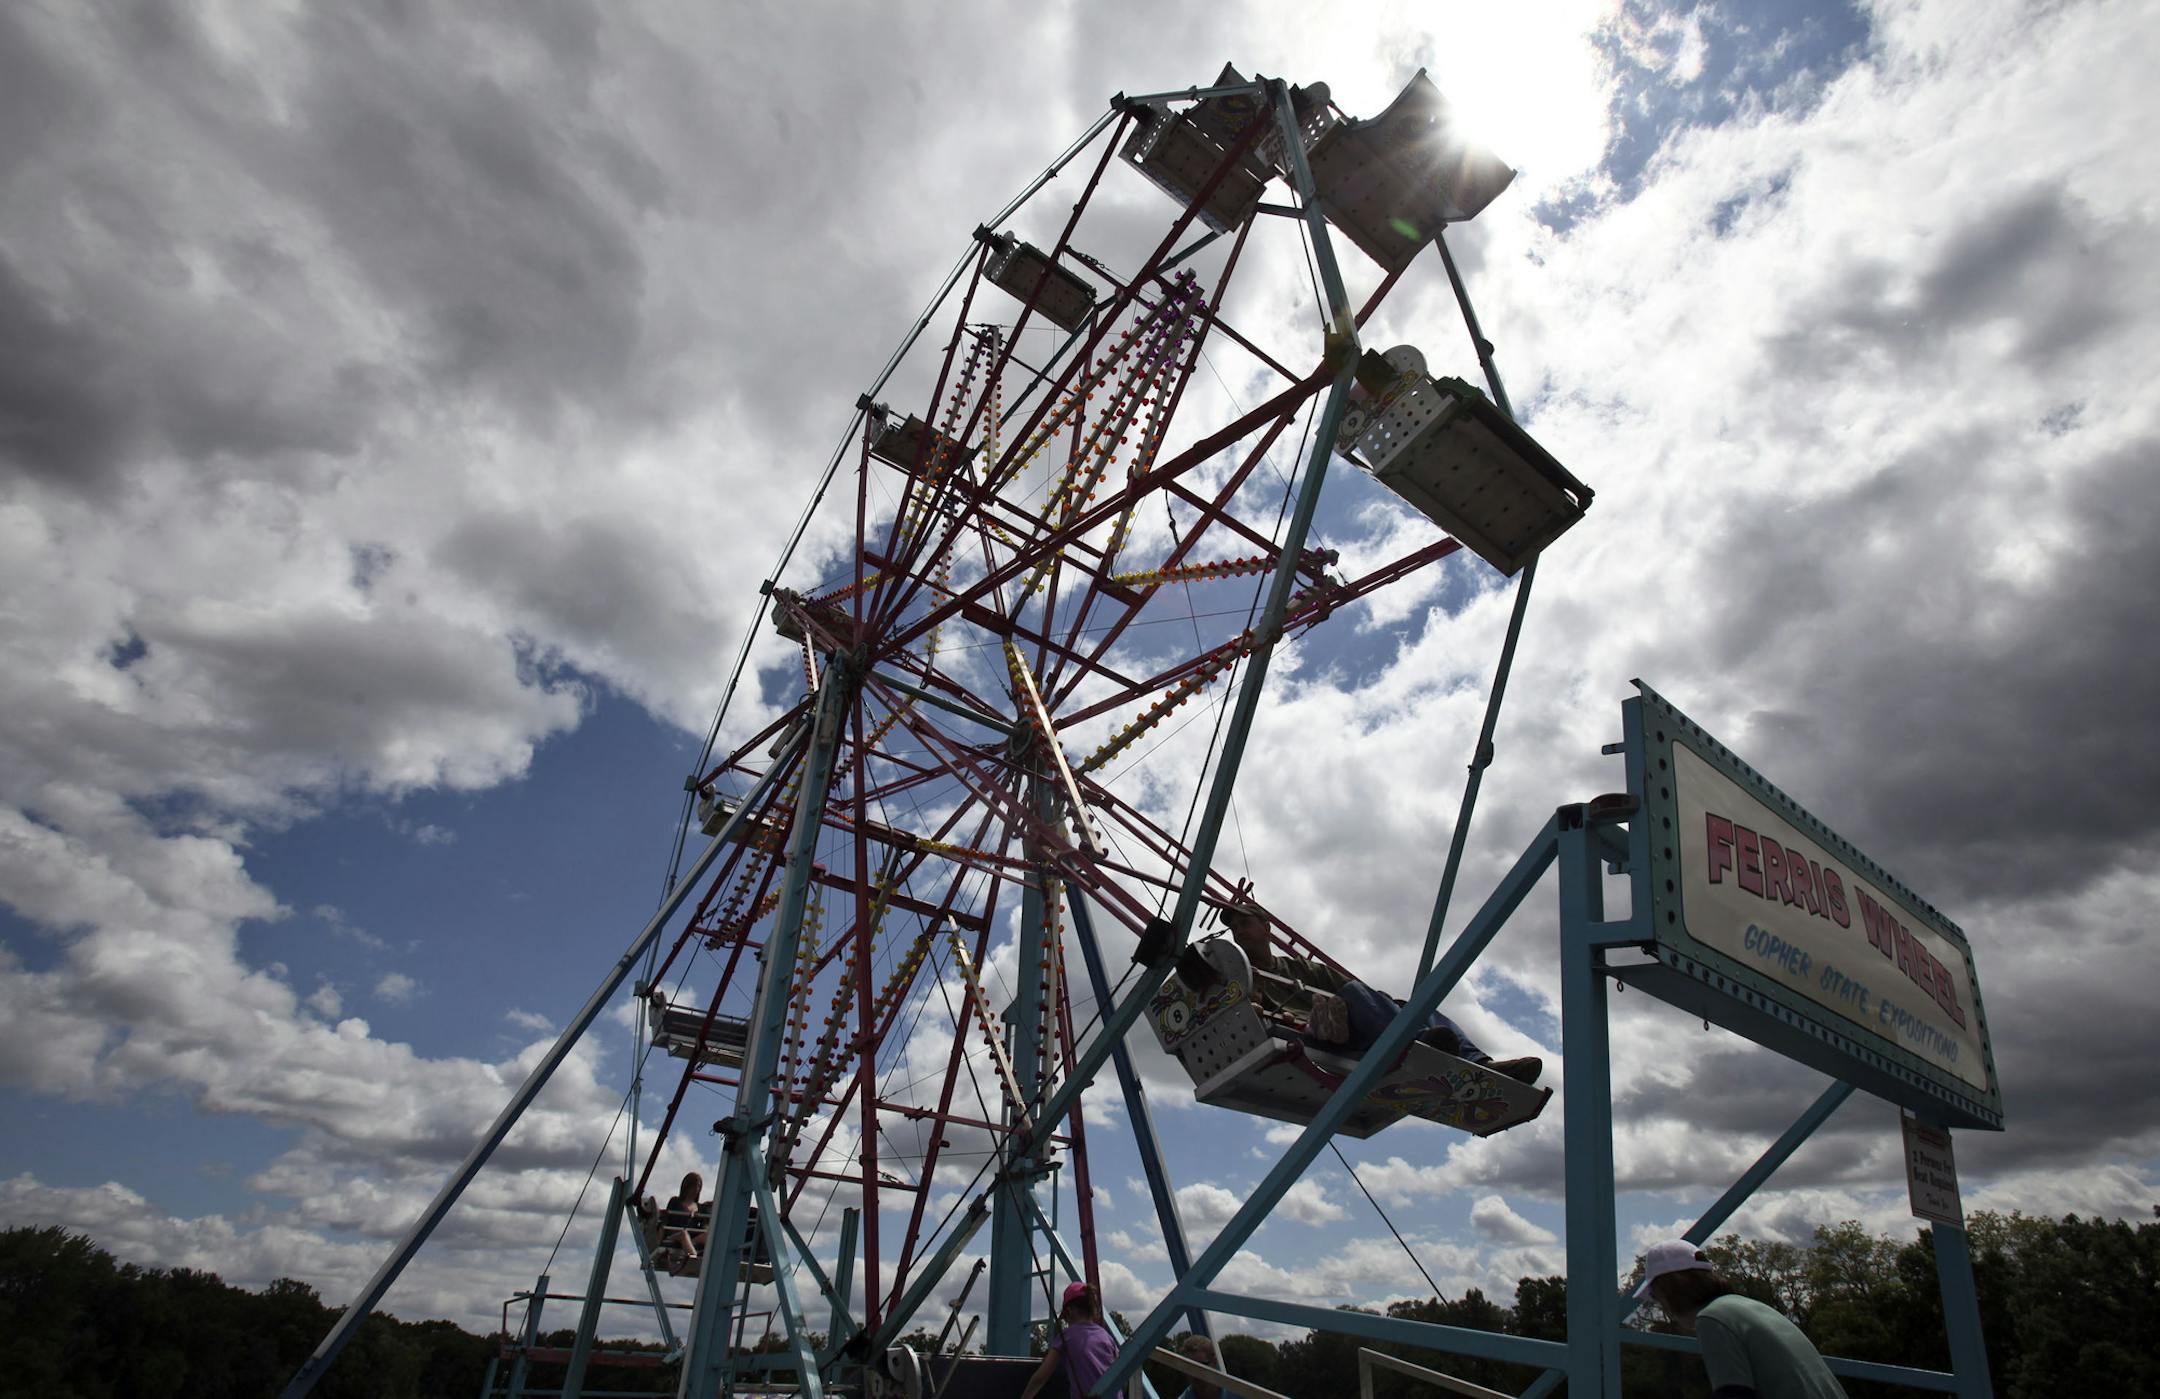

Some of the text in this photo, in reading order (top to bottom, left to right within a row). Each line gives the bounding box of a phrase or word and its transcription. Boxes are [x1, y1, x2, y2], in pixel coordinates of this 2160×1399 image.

[1705, 812, 1967, 1030] FERRIS WHEEL
[1173, 1009, 1182, 1023] 8
[1744, 923, 1959, 1063] GOPHER STATE EXPOSITIONS
